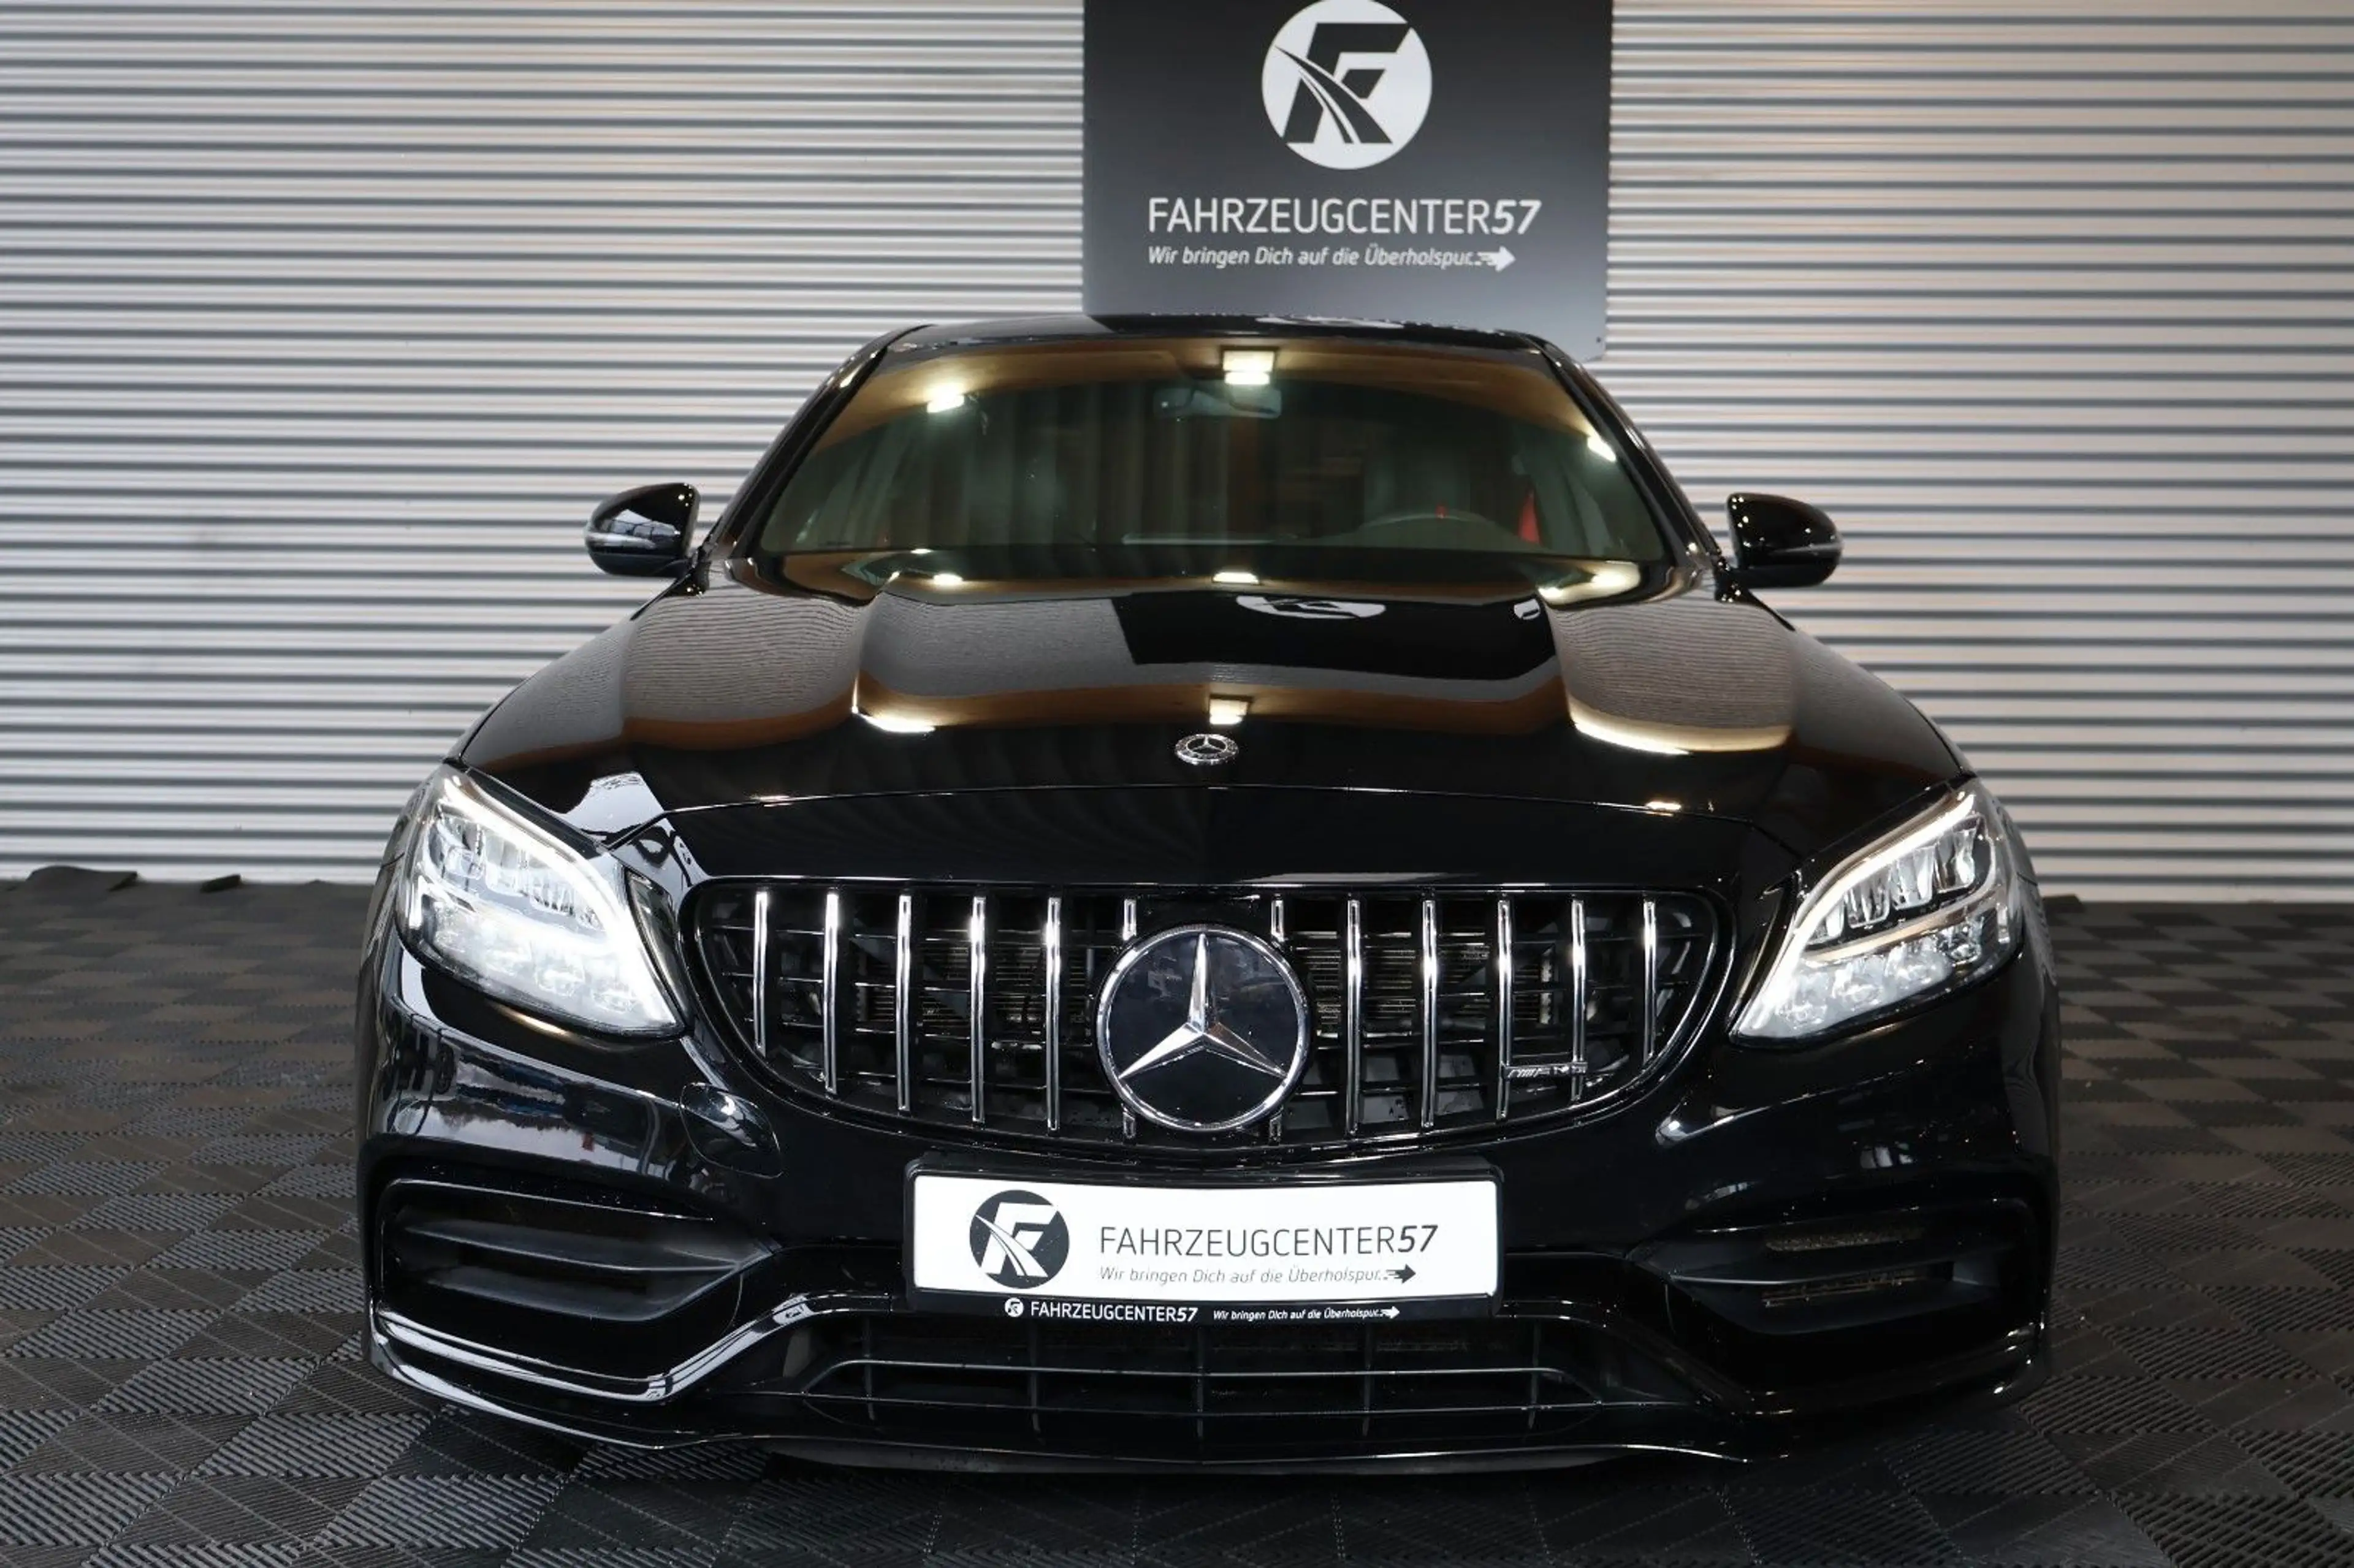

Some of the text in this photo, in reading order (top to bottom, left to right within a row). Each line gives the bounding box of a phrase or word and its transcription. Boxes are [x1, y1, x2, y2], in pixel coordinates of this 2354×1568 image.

[1149, 198, 1541, 234] FAHRZEUGCENTER57
[1149, 246, 1178, 264] Wir
[1183, 246, 1249, 268] bringen
[1255, 247, 1293, 264] Dich
[1298, 247, 1329, 265] auf
[1333, 248, 1359, 265] die
[1101, 1225, 1438, 1257] FAHRZEUGCENTER57
[1100, 1266, 1124, 1279] Wir
[1130, 1268, 1187, 1286] bringen
[1193, 1269, 1225, 1282] Dich
[1231, 1269, 1255, 1283] auf
[1261, 1270, 1282, 1282] die
[1031, 1301, 1198, 1322] FAHRZEUGCENTER57
